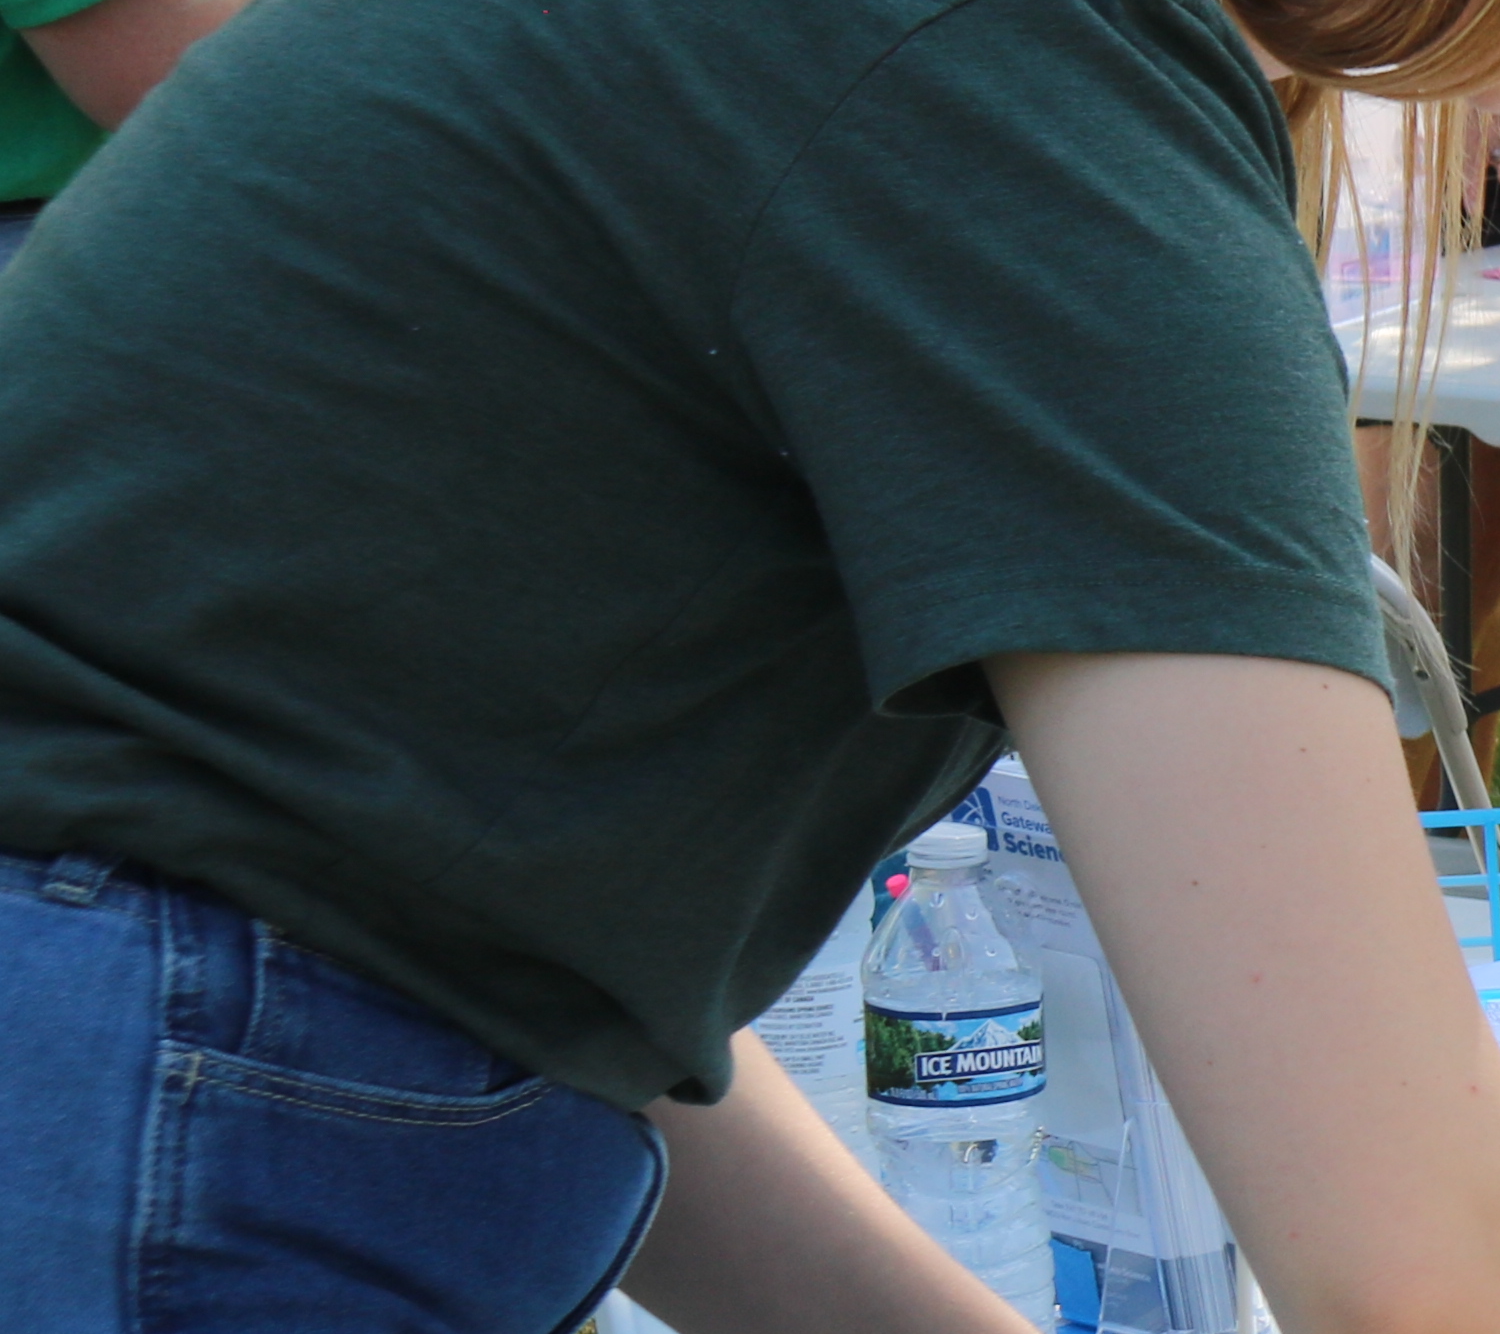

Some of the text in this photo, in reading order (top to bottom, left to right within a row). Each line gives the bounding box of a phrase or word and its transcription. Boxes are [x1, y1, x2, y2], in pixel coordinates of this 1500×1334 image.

[1001, 811, 1053, 834] Gatewa
[1003, 832, 1063, 862] Scien
[920, 1054, 952, 1078] ICE
